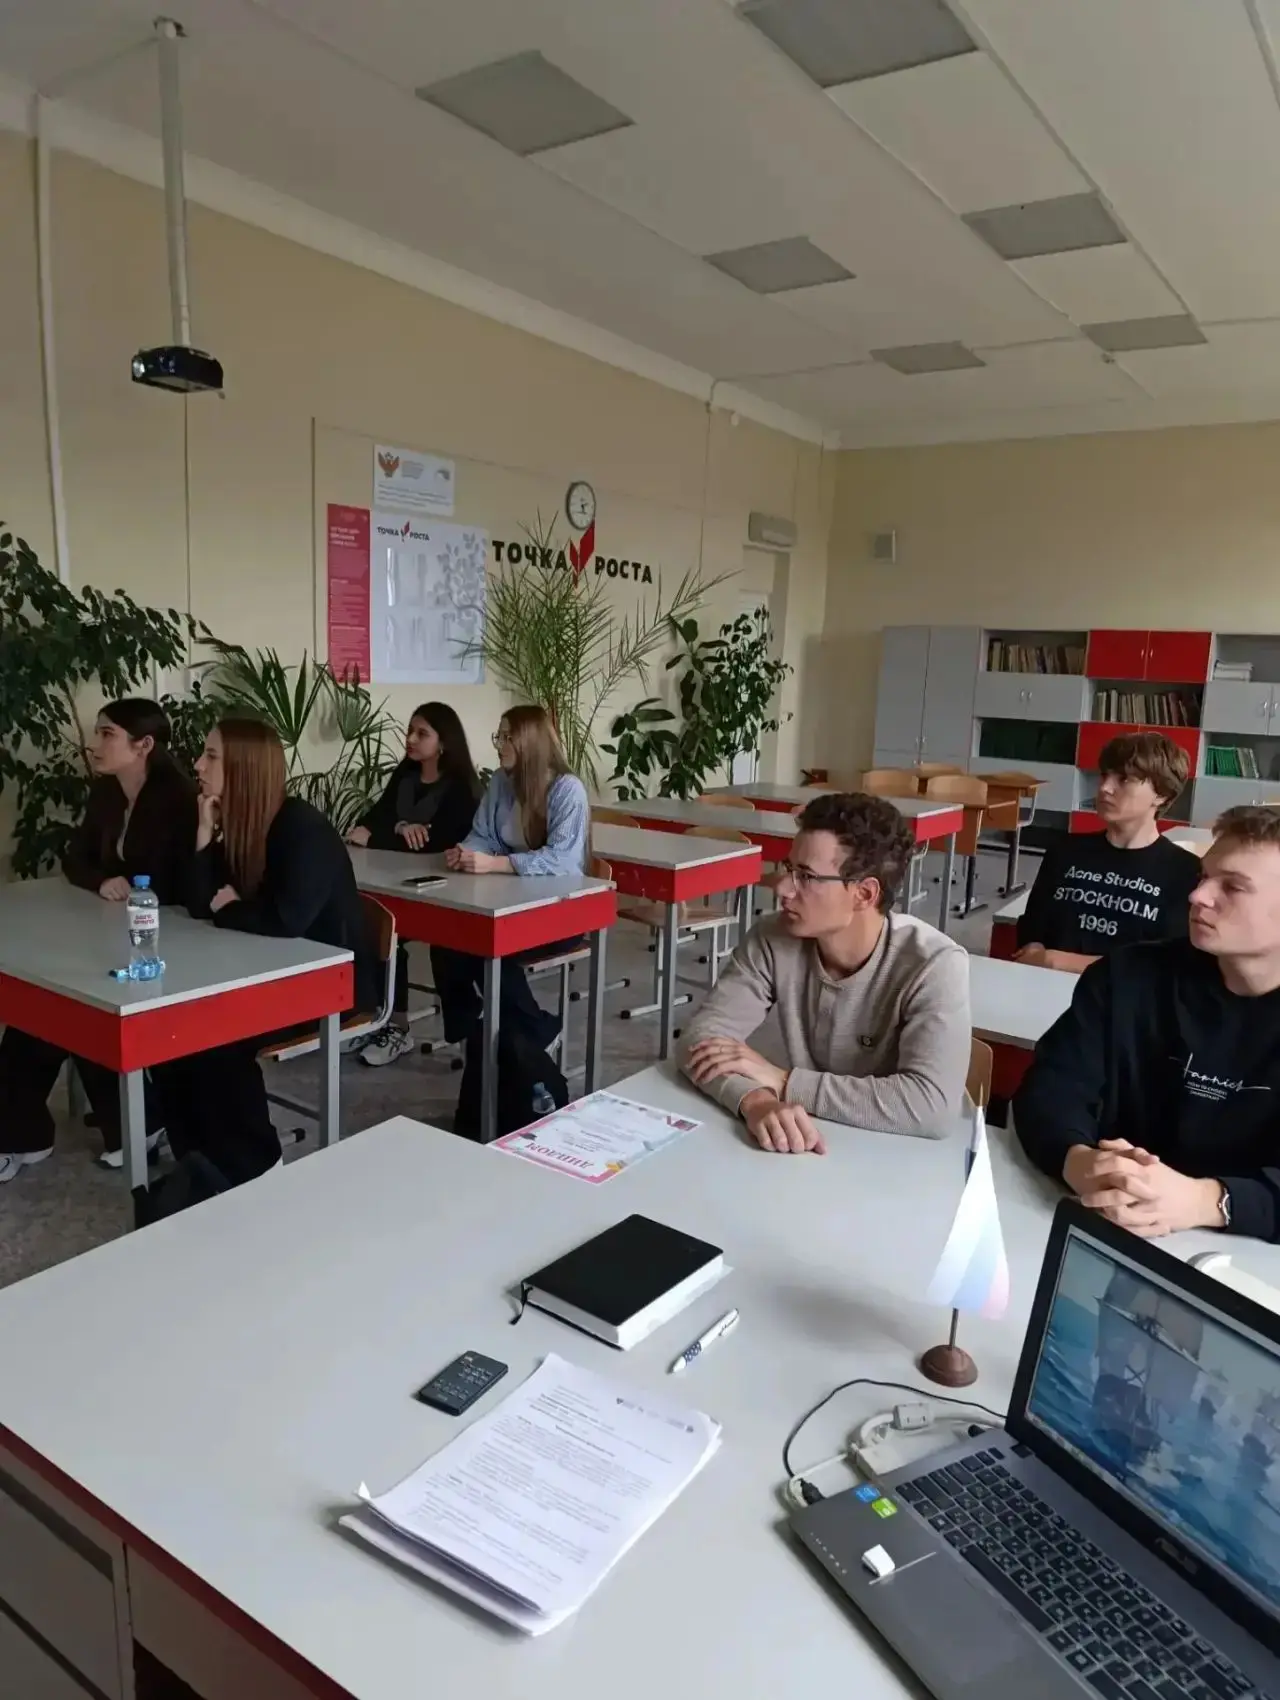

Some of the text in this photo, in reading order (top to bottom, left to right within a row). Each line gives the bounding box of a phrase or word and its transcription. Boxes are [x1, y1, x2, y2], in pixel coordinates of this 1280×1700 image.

[377, 526, 430, 541] ТОЧКА РОСТА
[492, 540, 652, 584] ТОЧКА РОСТА
[1064, 865, 1161, 897] Acne Studios
[1053, 887, 1159, 922] STOCKHOLM
[1078, 913, 1118, 936] 1996
